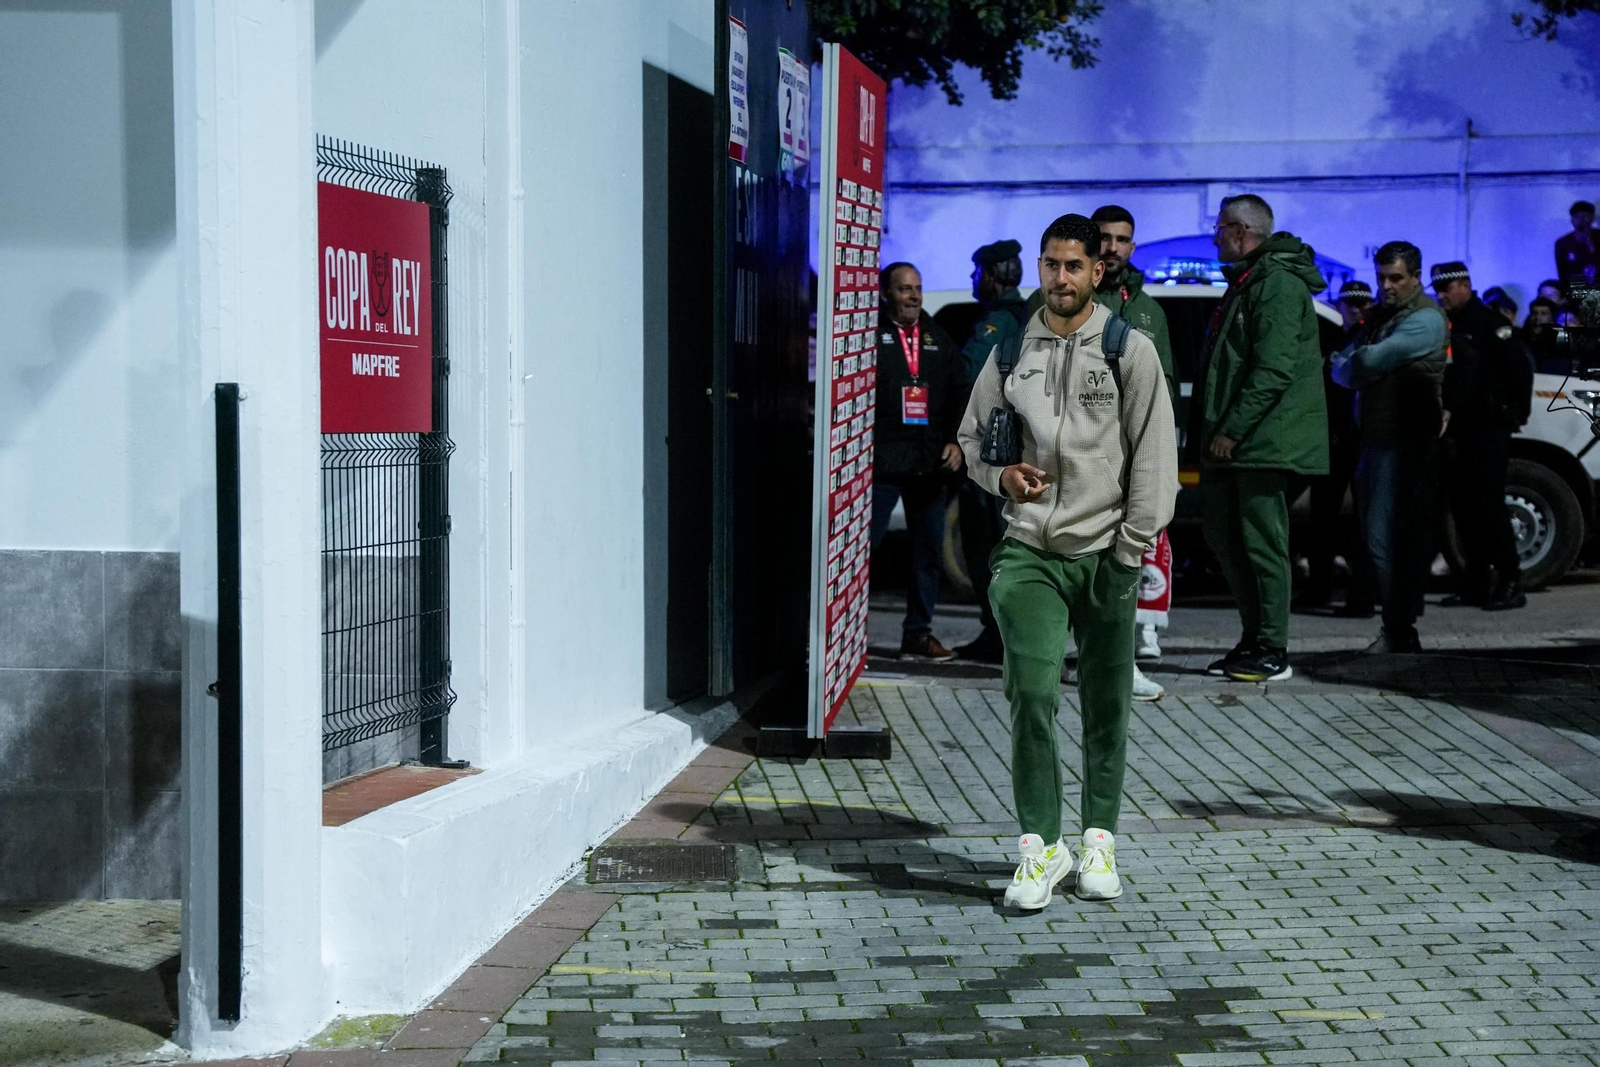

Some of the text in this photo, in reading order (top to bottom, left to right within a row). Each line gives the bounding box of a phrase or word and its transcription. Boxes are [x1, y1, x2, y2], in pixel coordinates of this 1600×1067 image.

[785, 88, 792, 129] 2
[325, 246, 421, 336] COPA DEL REY
[352, 353, 400, 377] MAPFRE
[1078, 393, 1114, 401] PAMESA
